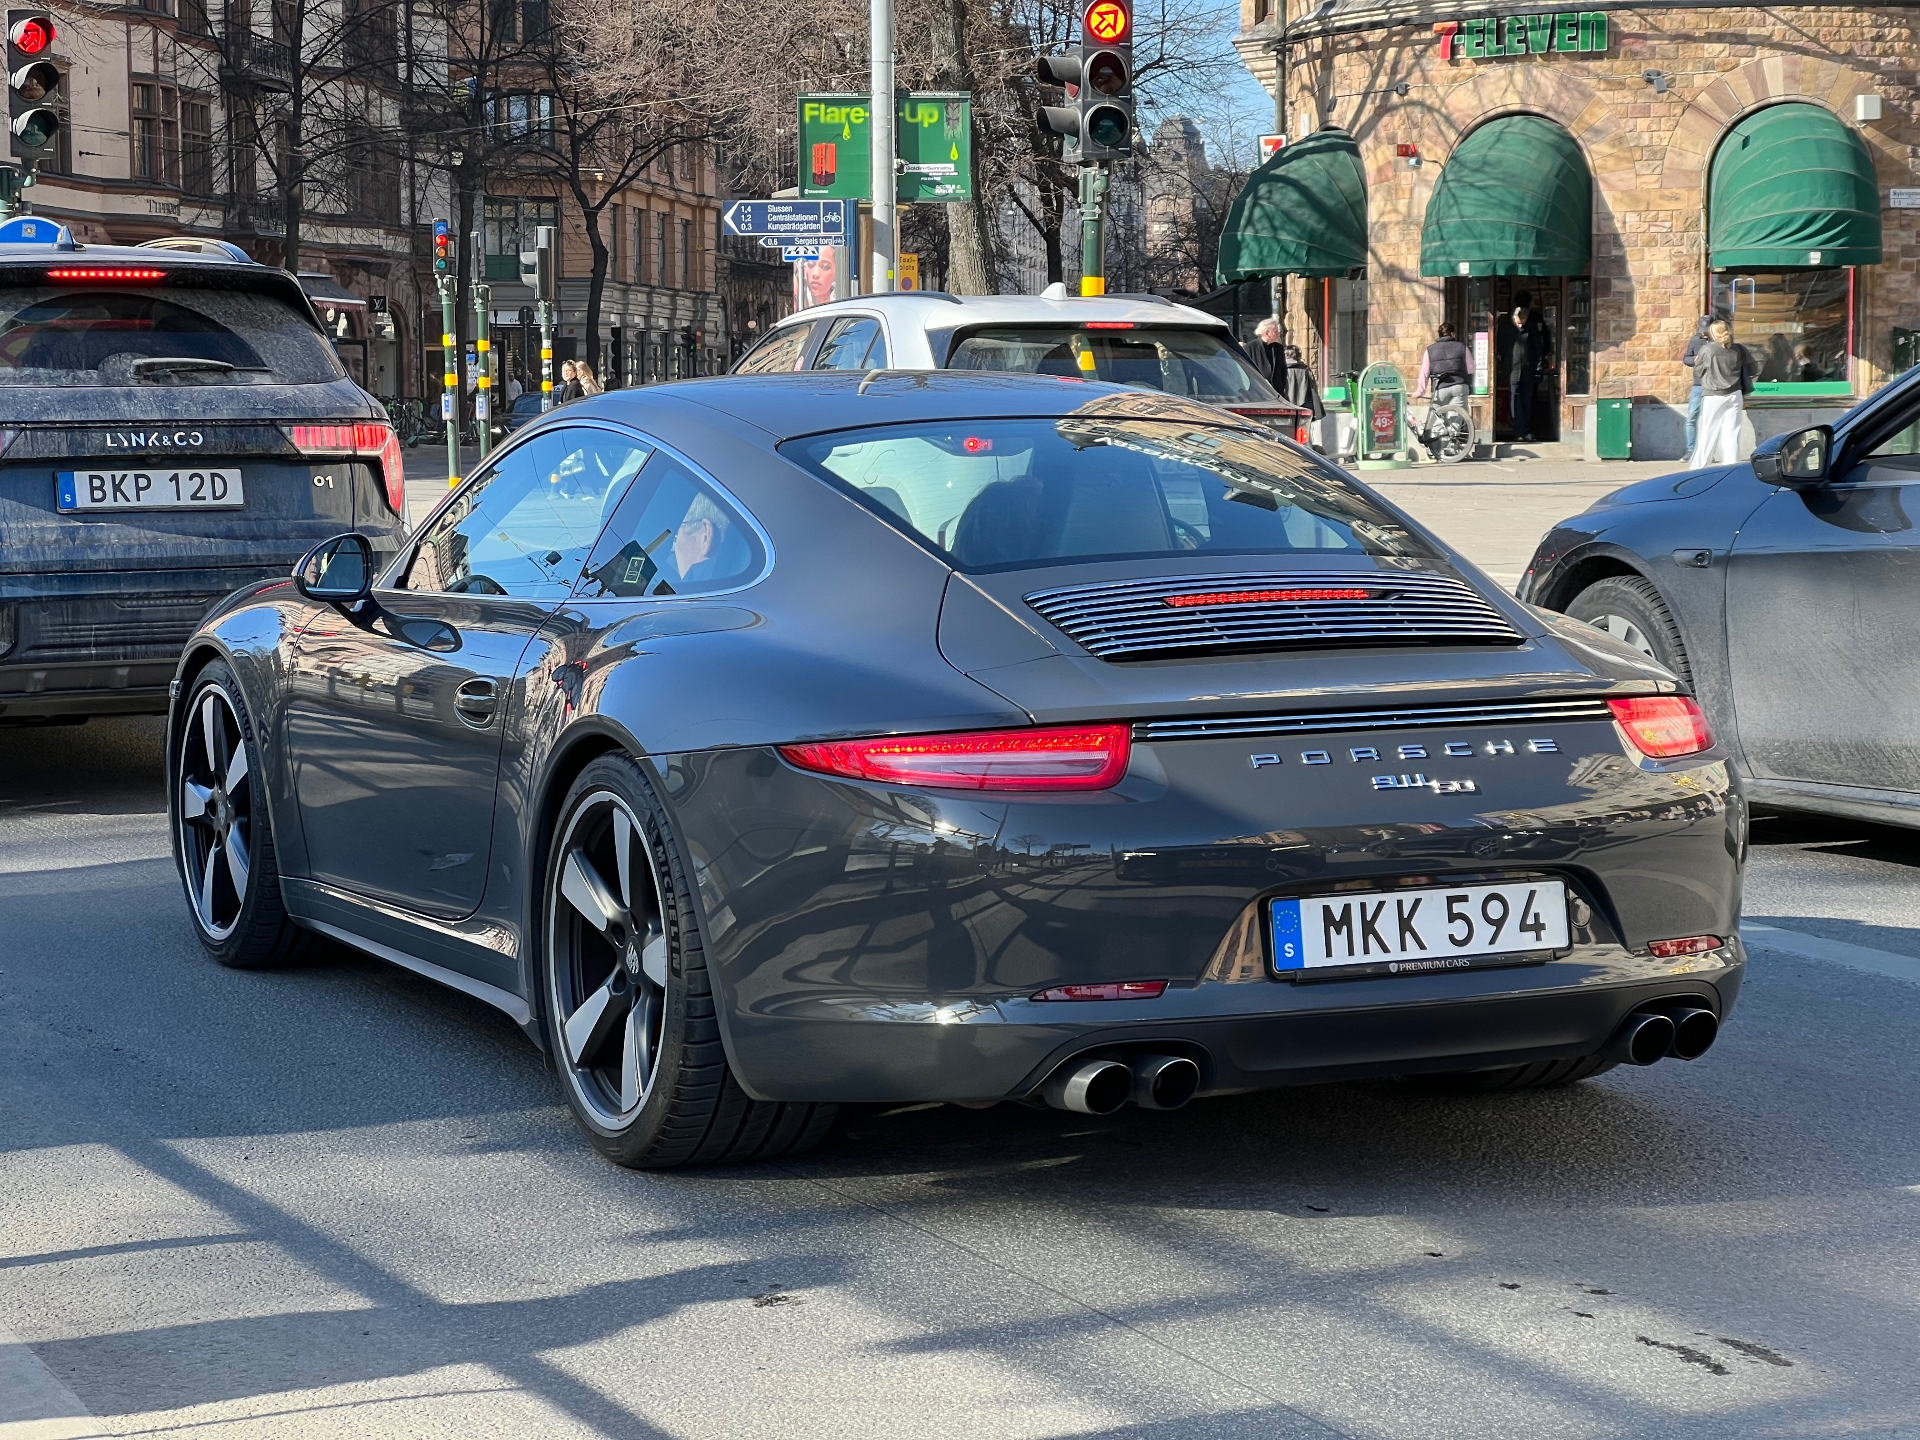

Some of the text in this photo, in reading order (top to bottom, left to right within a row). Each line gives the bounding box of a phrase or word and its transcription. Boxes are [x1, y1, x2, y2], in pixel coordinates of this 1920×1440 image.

[767, 222, 821, 232] Kungsträdgården
[794, 237, 818, 246] Sergels
[819, 238, 833, 246] torg
[64, 472, 228, 503] S BKP 12D
[1250, 738, 1558, 769] PORSCHE
[656, 845, 681, 969] MICHELIN
[1284, 889, 1547, 958] S MKK 594
[1400, 958, 1471, 972] PREMIUM CARS
